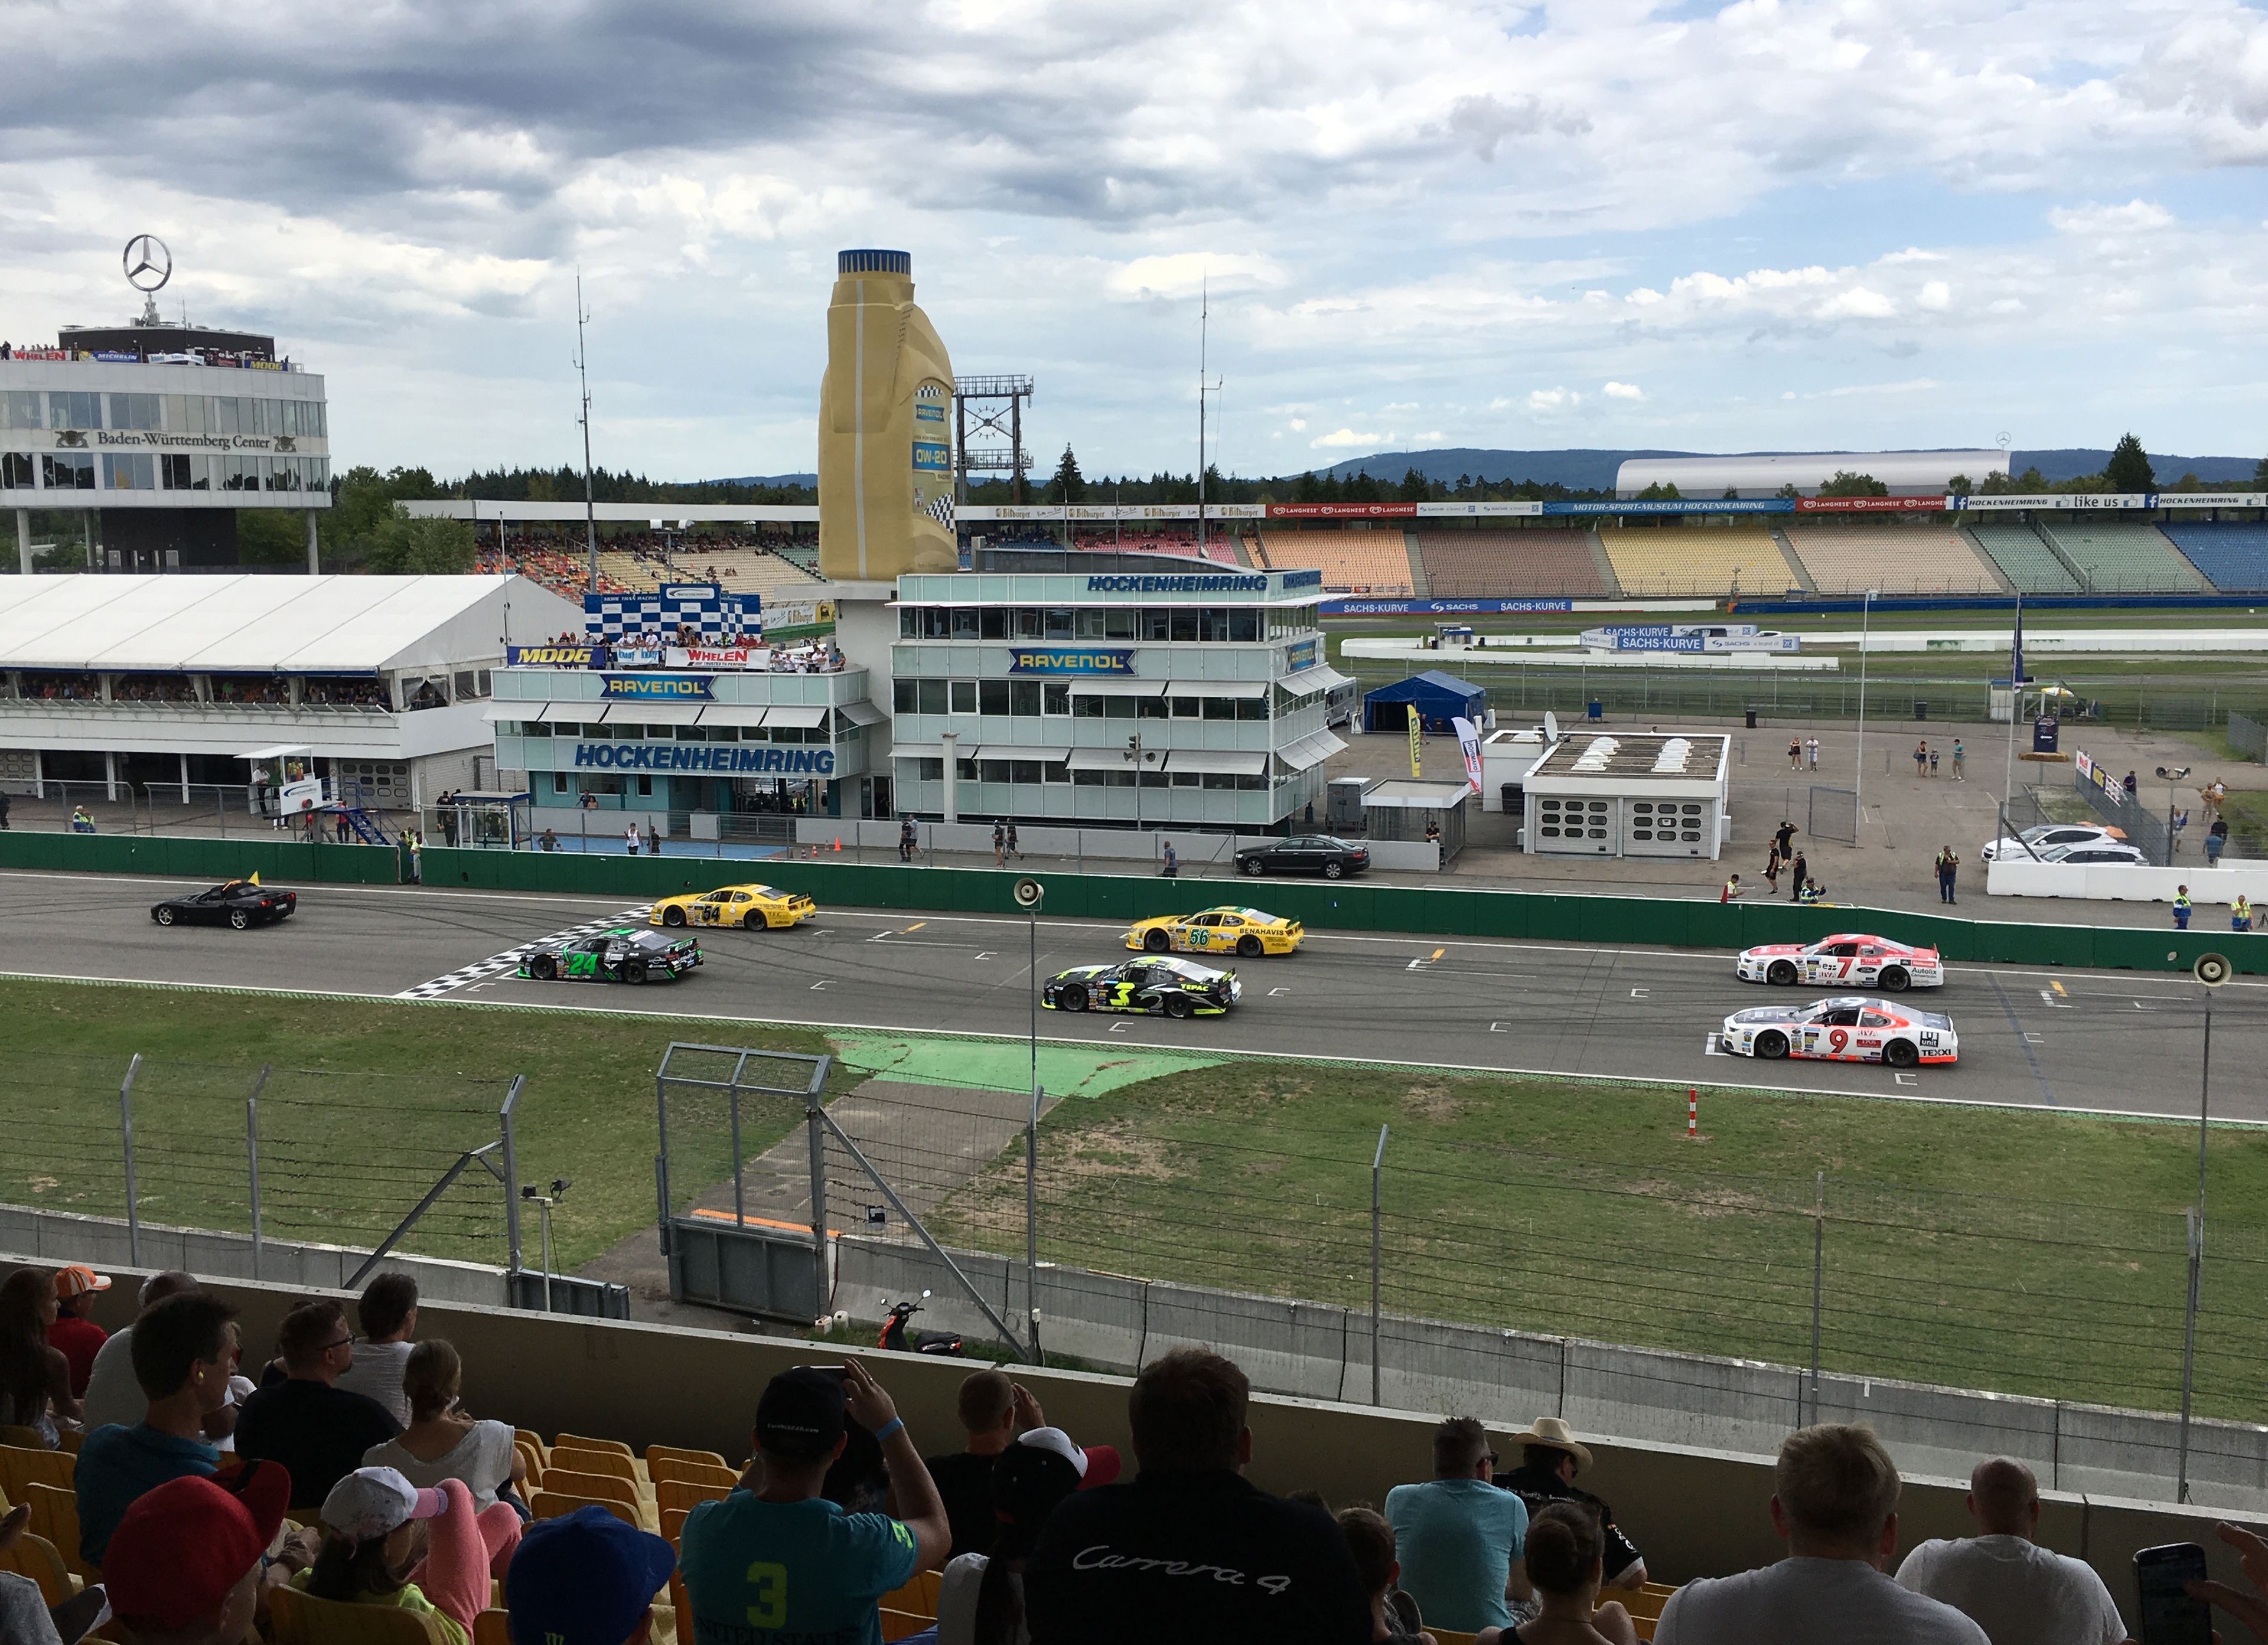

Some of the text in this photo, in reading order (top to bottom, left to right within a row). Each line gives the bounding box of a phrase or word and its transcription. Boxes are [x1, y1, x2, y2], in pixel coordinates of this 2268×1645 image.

[12, 350, 66, 360] WHELEN
[250, 361, 283, 370] MOOG
[97, 431, 271, 451] Baden-Württemberg Center
[1572, 502, 1765, 511] MOTOR-SPORT-MUSEUM HOCKENHEIMRING
[2074, 496, 2098, 507] like
[2104, 498, 2118, 507] us
[1002, 508, 1030, 519] Bitburger
[1076, 507, 1105, 518] Bitburger
[1151, 507, 1181, 517] Bitburger
[1228, 506, 1258, 517] Bitburger
[1087, 576, 1269, 590] HOCKENHEIMRING
[1344, 604, 1409, 613] SACHS-KURVE
[1500, 602, 1566, 611] SACHS-KURVE
[1606, 628, 1669, 637] SACHS-KURVE
[1622, 638, 1700, 649] SACHS-KURVE
[517, 648, 594, 663] MOOG
[686, 649, 748, 661] WHELEN
[1020, 655, 1124, 668] RAVENOL
[610, 680, 705, 694] RAVENOL
[575, 745, 835, 773] HOCKENHEIMRING
[702, 903, 722, 921] 54
[1188, 928, 1210, 947] 56
[569, 954, 598, 974] 24
[1837, 958, 1855, 978] 7
[1110, 983, 1135, 1006] 3
[1829, 1029, 1849, 1053] 9
[1072, 1545, 1246, 1585] Carrera
[746, 1561, 788, 1629] 3
